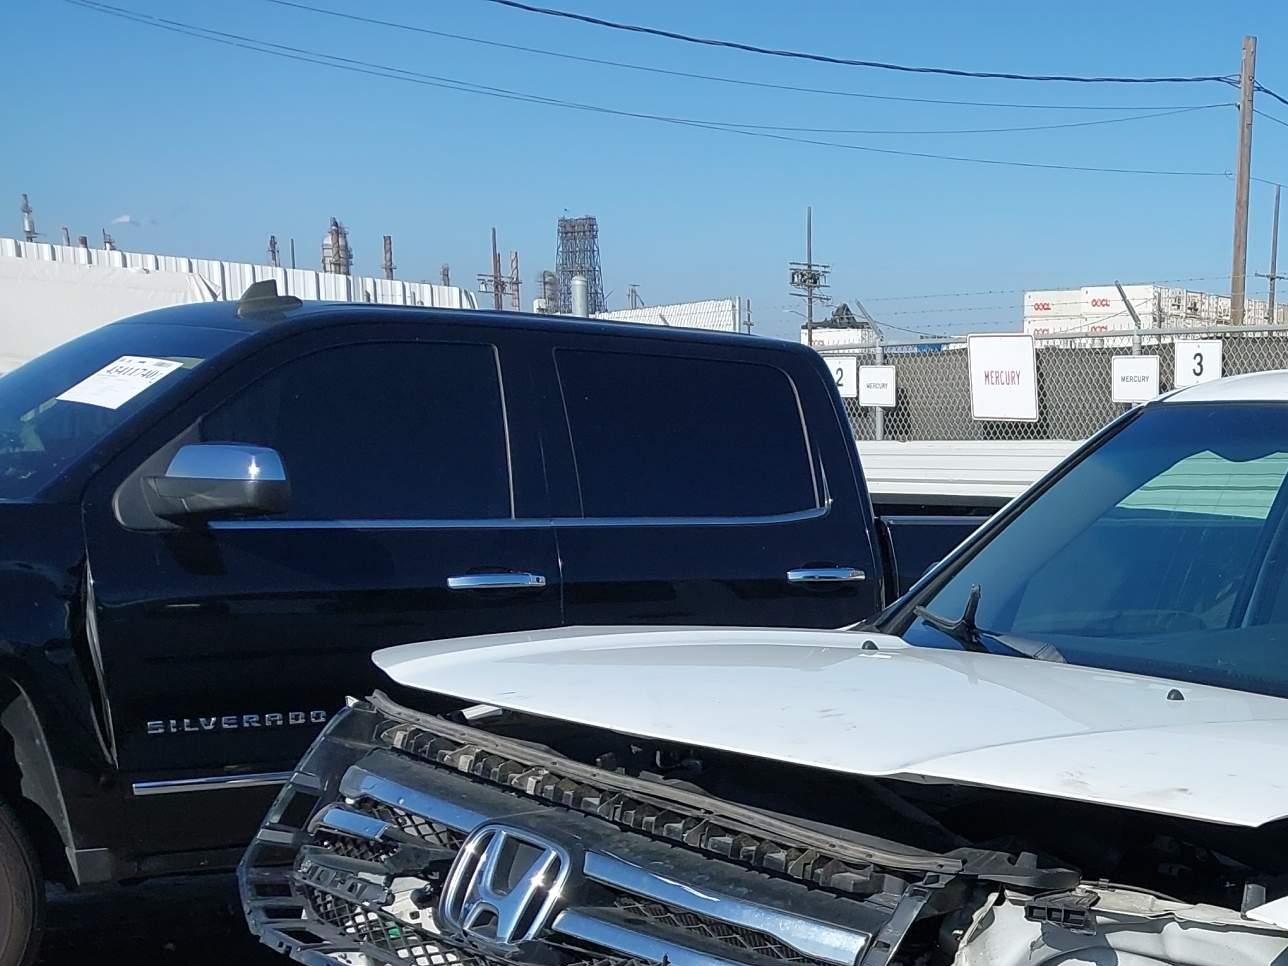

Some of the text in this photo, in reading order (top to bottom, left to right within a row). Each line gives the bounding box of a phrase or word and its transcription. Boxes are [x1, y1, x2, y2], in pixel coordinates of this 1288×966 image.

[1033, 302, 1052, 311] OOCL
[1192, 352, 1204, 377] 3
[835, 367, 844, 387] 2
[983, 369, 1021, 386] MERCURY
[1120, 375, 1149, 383] MERCURY
[147, 710, 327, 734] SILVERADO
